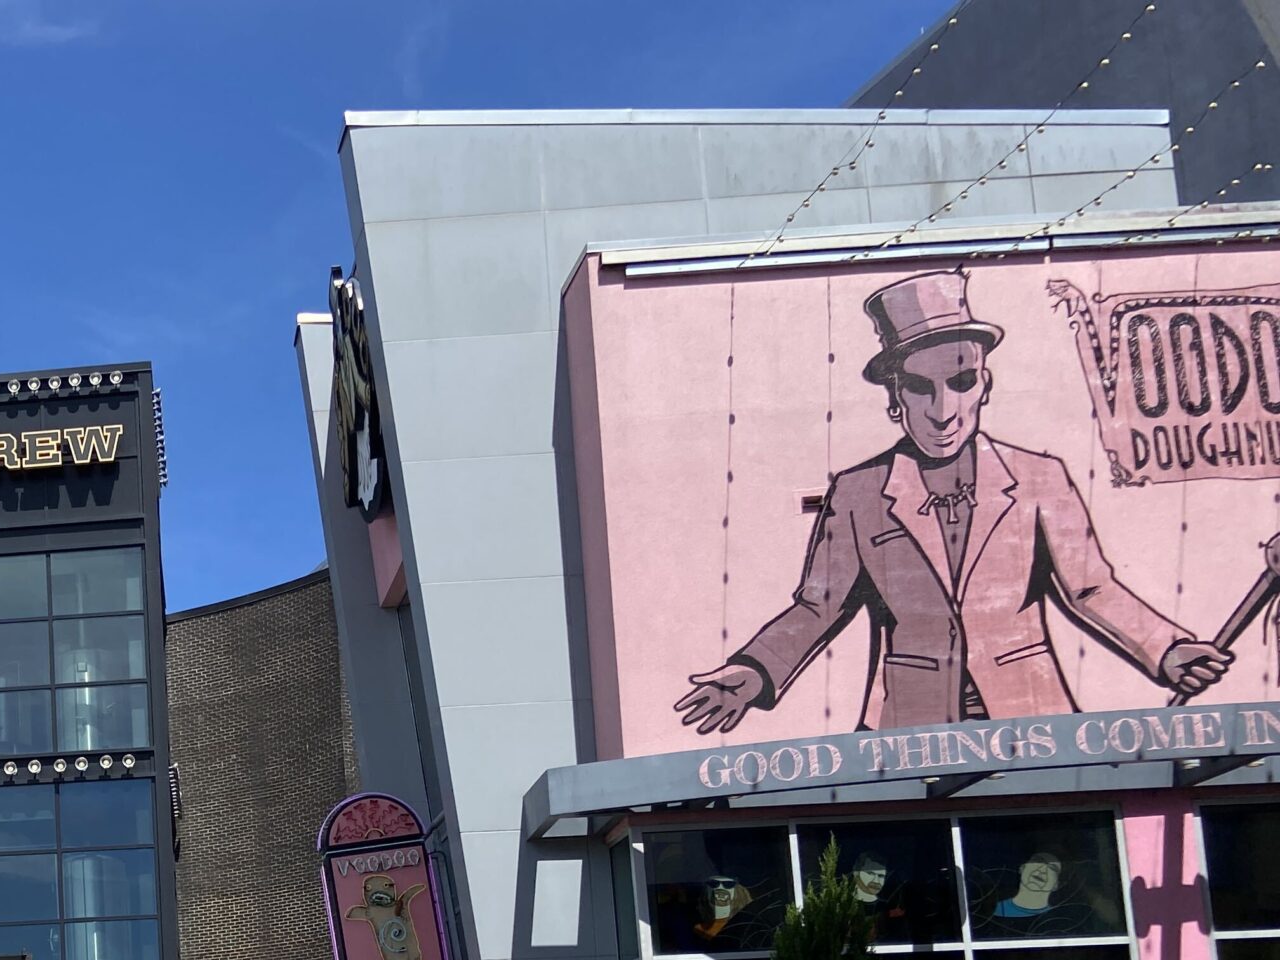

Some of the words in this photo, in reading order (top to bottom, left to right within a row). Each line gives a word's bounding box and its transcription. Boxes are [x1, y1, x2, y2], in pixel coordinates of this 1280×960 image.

[698, 741, 844, 789] GOOD
[859, 722, 1057, 773] THINGS
[1075, 712, 1226, 756] COME
[336, 849, 420, 877] VOODOO
